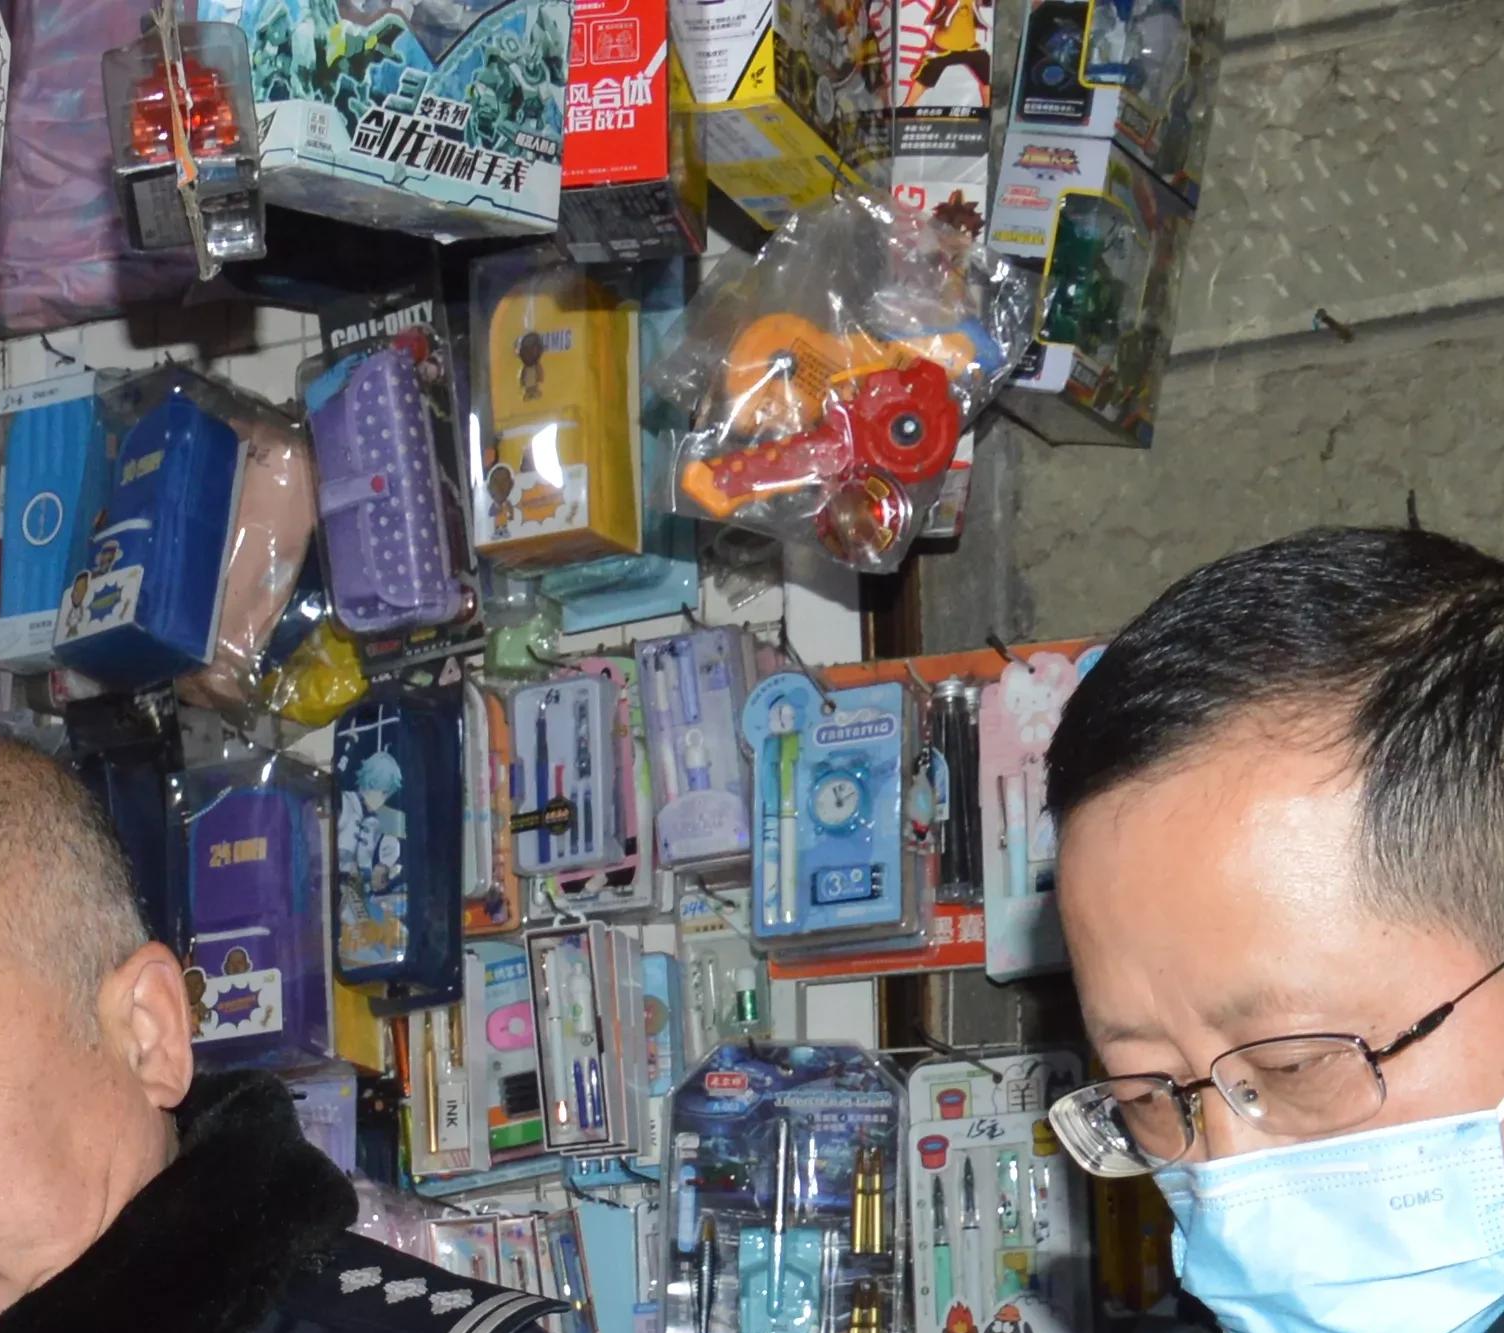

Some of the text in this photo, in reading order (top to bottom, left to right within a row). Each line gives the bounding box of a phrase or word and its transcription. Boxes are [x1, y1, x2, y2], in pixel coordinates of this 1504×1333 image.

[565, 70, 653, 109] 风合体
[563, 108, 635, 133] 倍战力
[349, 109, 535, 194] 剑龙机械手表
